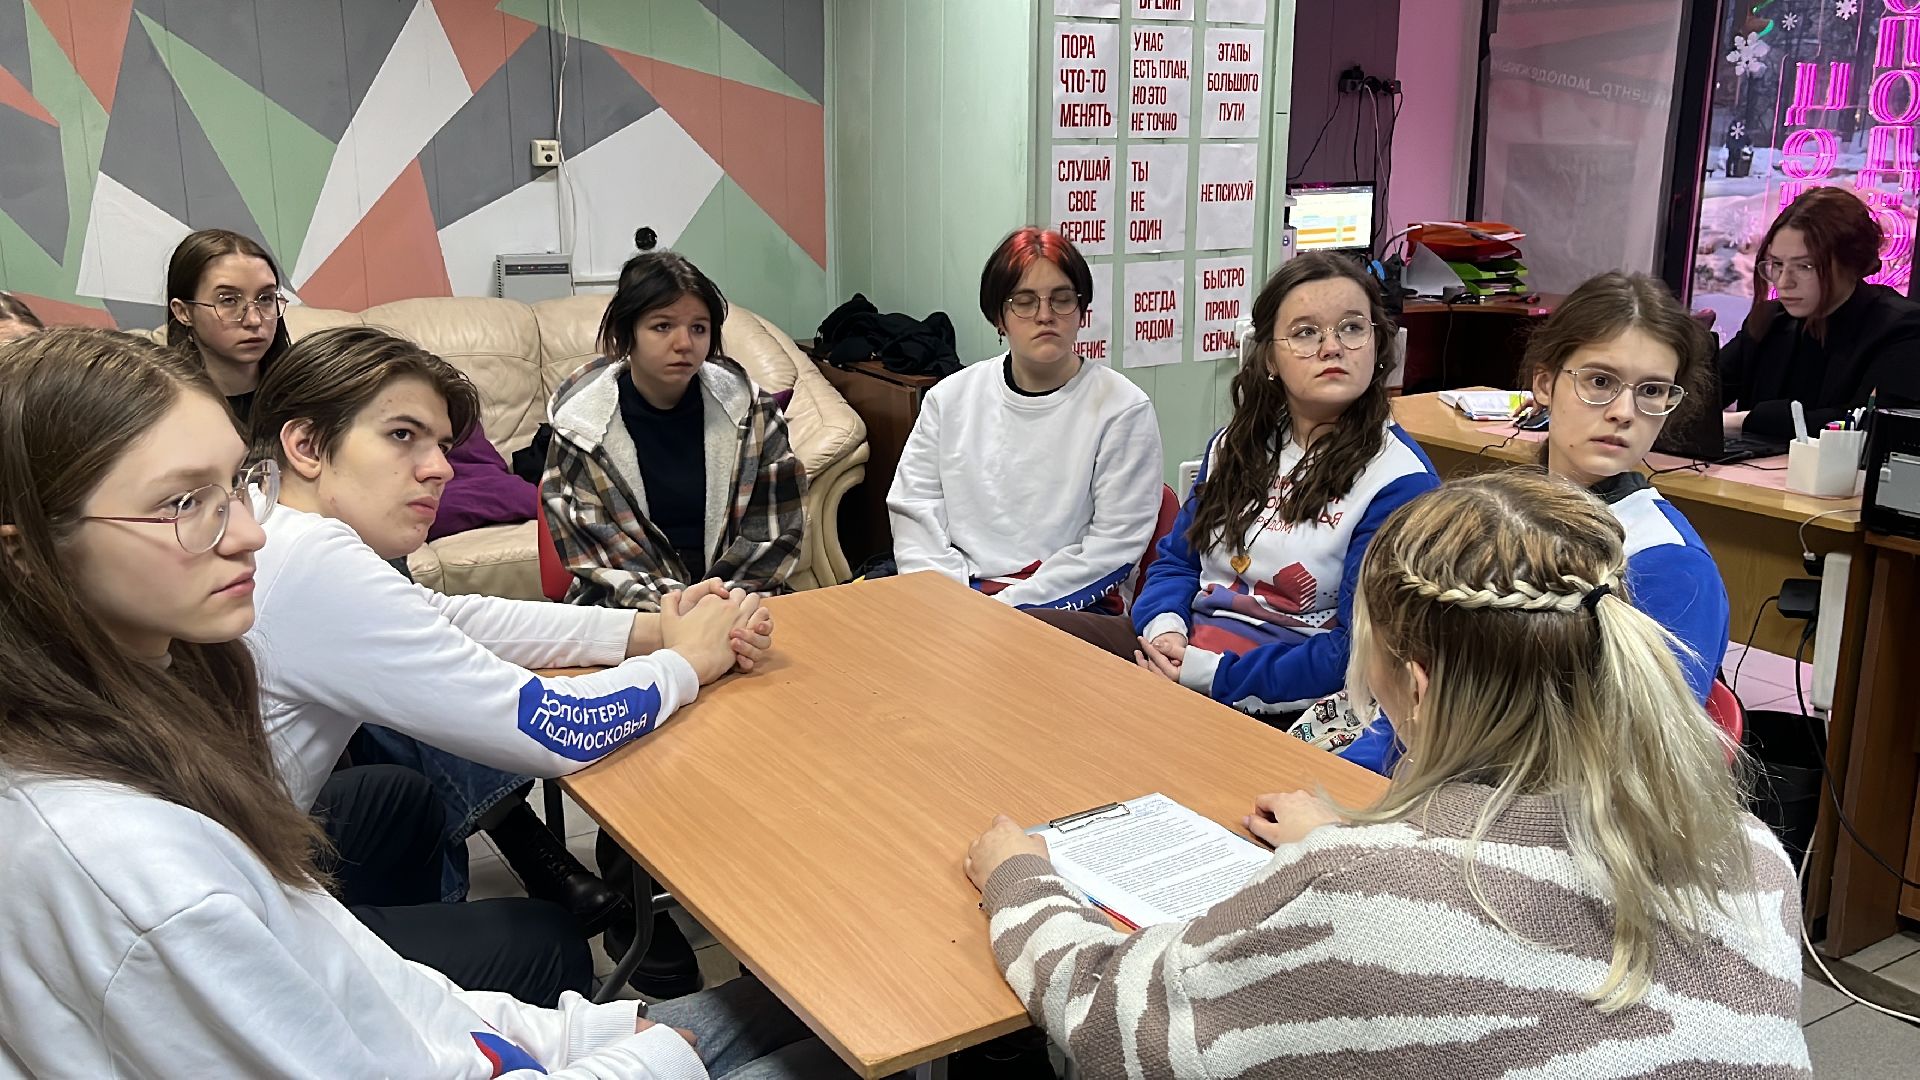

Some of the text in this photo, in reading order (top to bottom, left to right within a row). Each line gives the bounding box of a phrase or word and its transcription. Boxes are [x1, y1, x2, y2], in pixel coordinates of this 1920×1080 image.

[1061, 34, 1096, 59] ПОРА
[1133, 31, 1164, 52] У НАС
[1217, 42, 1251, 62] ЭТАПЫ
[1060, 68, 1107, 94] ЧТО-ТО
[1133, 59, 1190, 80] ЕСТЬ ПЛАН,
[1207, 72, 1259, 92] БОЛЬШОГО
[1132, 85, 1167, 106] НО ЭТО
[1059, 103, 1112, 128] МЕНЯТЬ
[1131, 112, 1178, 132] НЕ ТОЧНО
[1219, 102, 1245, 122] ПУТИ
[1058, 156, 1111, 182] СЛУШАЙ
[1131, 160, 1149, 182] ТЫ
[1068, 189, 1097, 213] СВОЕ
[1130, 190, 1146, 212] НЕ
[1200, 180, 1254, 203] НЕ ПСИХУЙ
[1059, 219, 1107, 244] СЕРДЦЕ
[1129, 219, 1162, 244] ОДИН
[1203, 267, 1245, 290] БЫСТРО
[1134, 289, 1177, 313] ВСЕГДА
[1204, 299, 1240, 322] ПРЯМО
[1135, 318, 1174, 343] РЯДОМ
